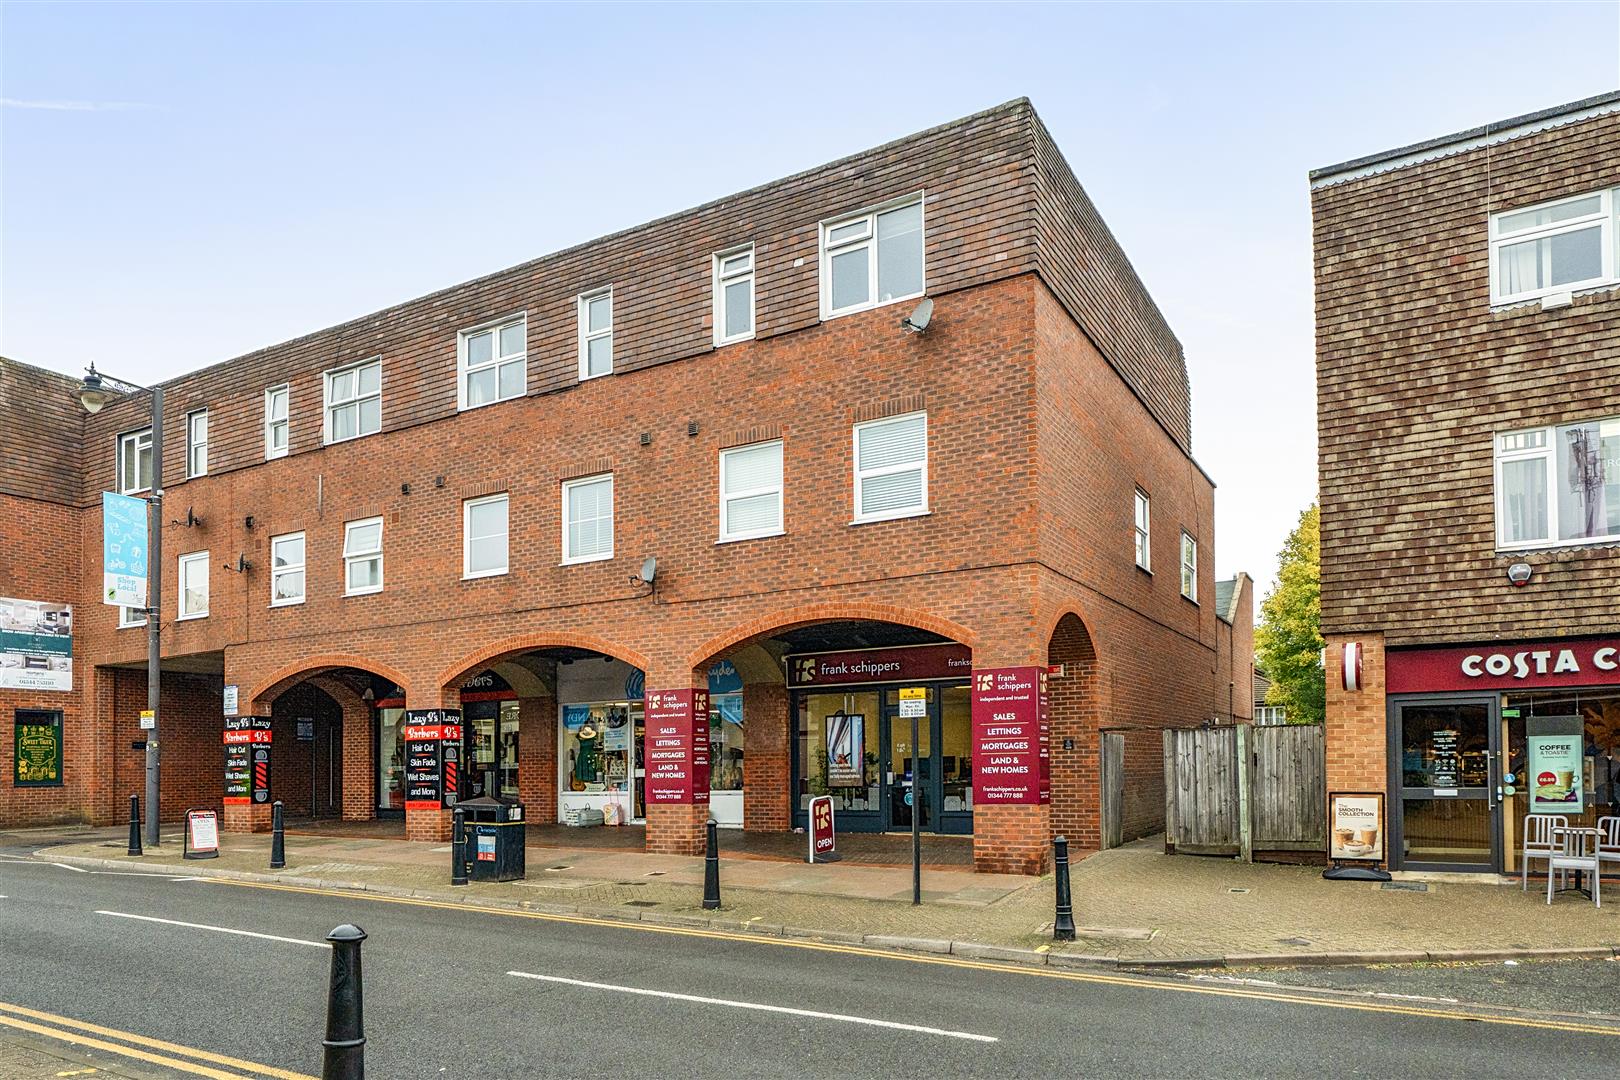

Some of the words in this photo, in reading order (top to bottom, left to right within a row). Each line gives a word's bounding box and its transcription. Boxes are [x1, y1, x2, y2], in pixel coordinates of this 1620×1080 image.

[117, 577, 136, 585] Shop
[821, 662, 848, 675] frank
[850, 660, 900, 676] schippers
[1461, 649, 1580, 679] COSTA
[997, 674, 1017, 682] frank
[997, 682, 1032, 692] schippers
[408, 712, 427, 726] Lazy
[442, 711, 460, 724] Lazy
[226, 718, 241, 730] Lazy
[251, 718, 271, 729] Lazy
[226, 732, 250, 742] Barbers
[408, 727, 439, 739] Barbers
[444, 726, 458, 738] B's
[988, 728, 1022, 736] LETTINGS
[424, 744, 434, 752] Cut
[982, 742, 1029, 750] MORTGAGES
[422, 758, 436, 766] Fade
[420, 772, 440, 780] Shaves
[817, 838, 832, 848] OPEN
